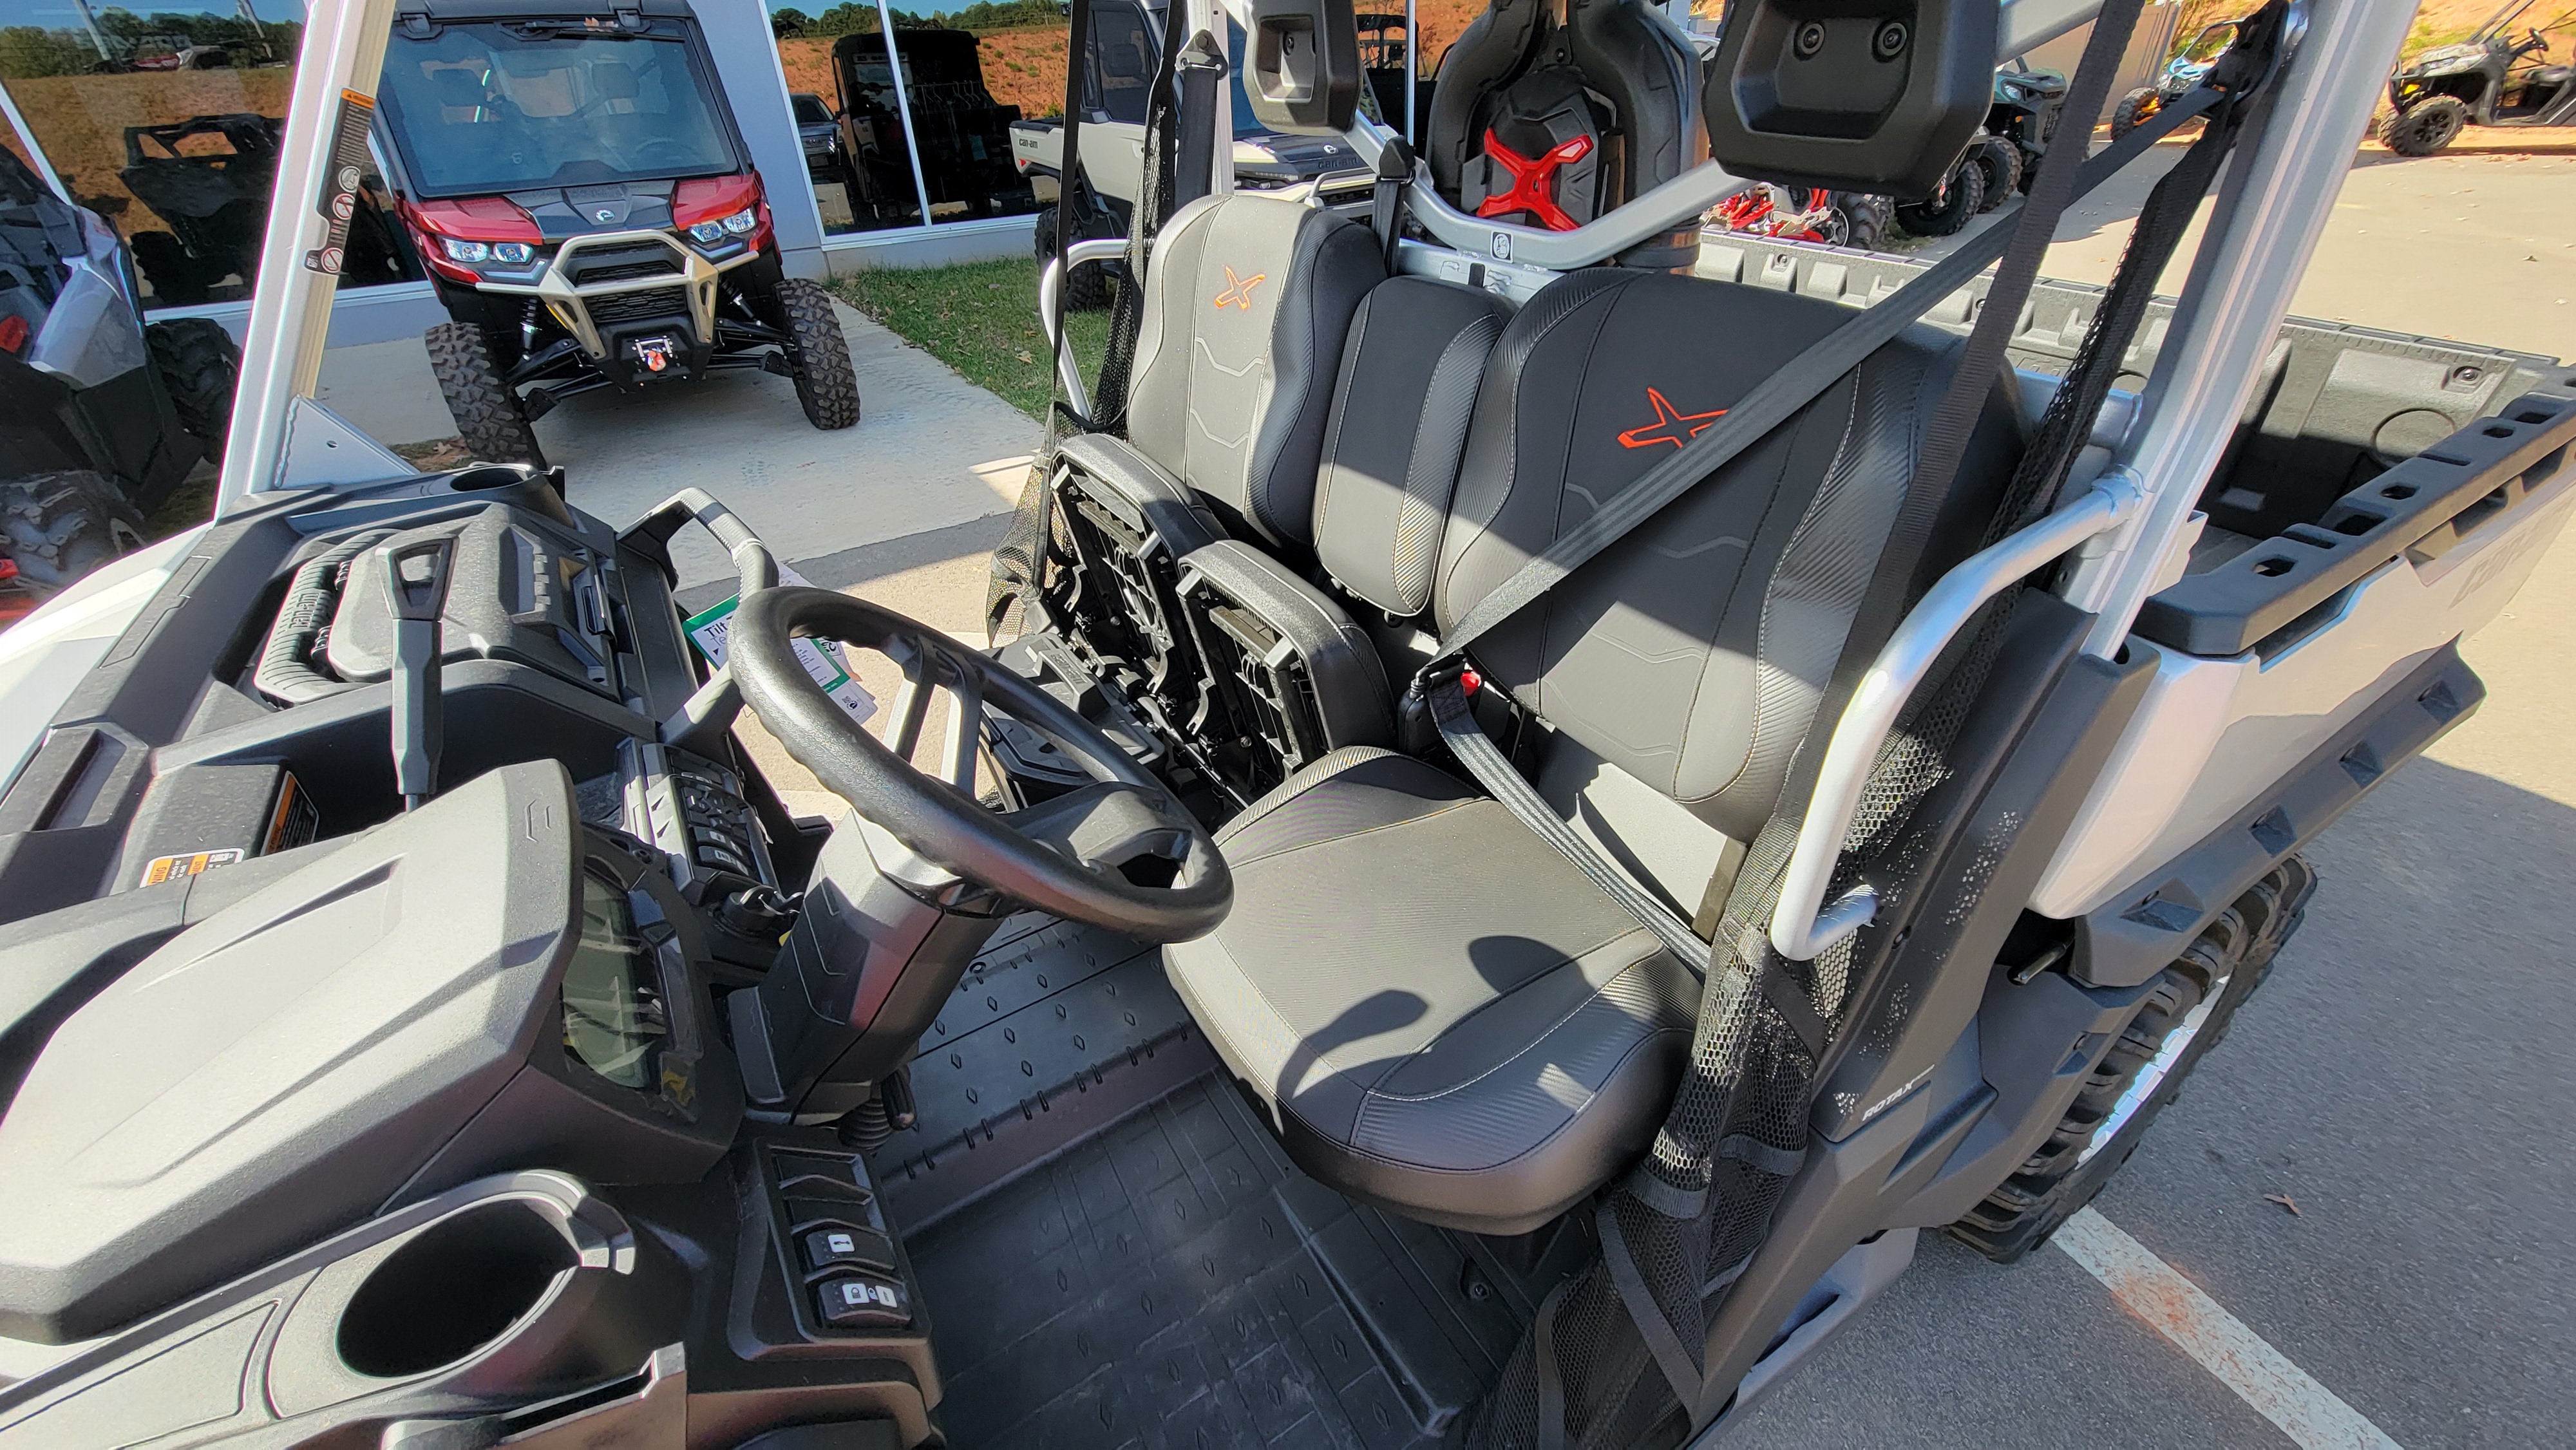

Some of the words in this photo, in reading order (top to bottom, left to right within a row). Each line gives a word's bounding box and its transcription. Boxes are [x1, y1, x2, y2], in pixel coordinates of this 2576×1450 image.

[1019, 138, 1038, 149] can-am
[288, 592, 321, 629] can-am
[703, 621, 728, 637] Tilt
